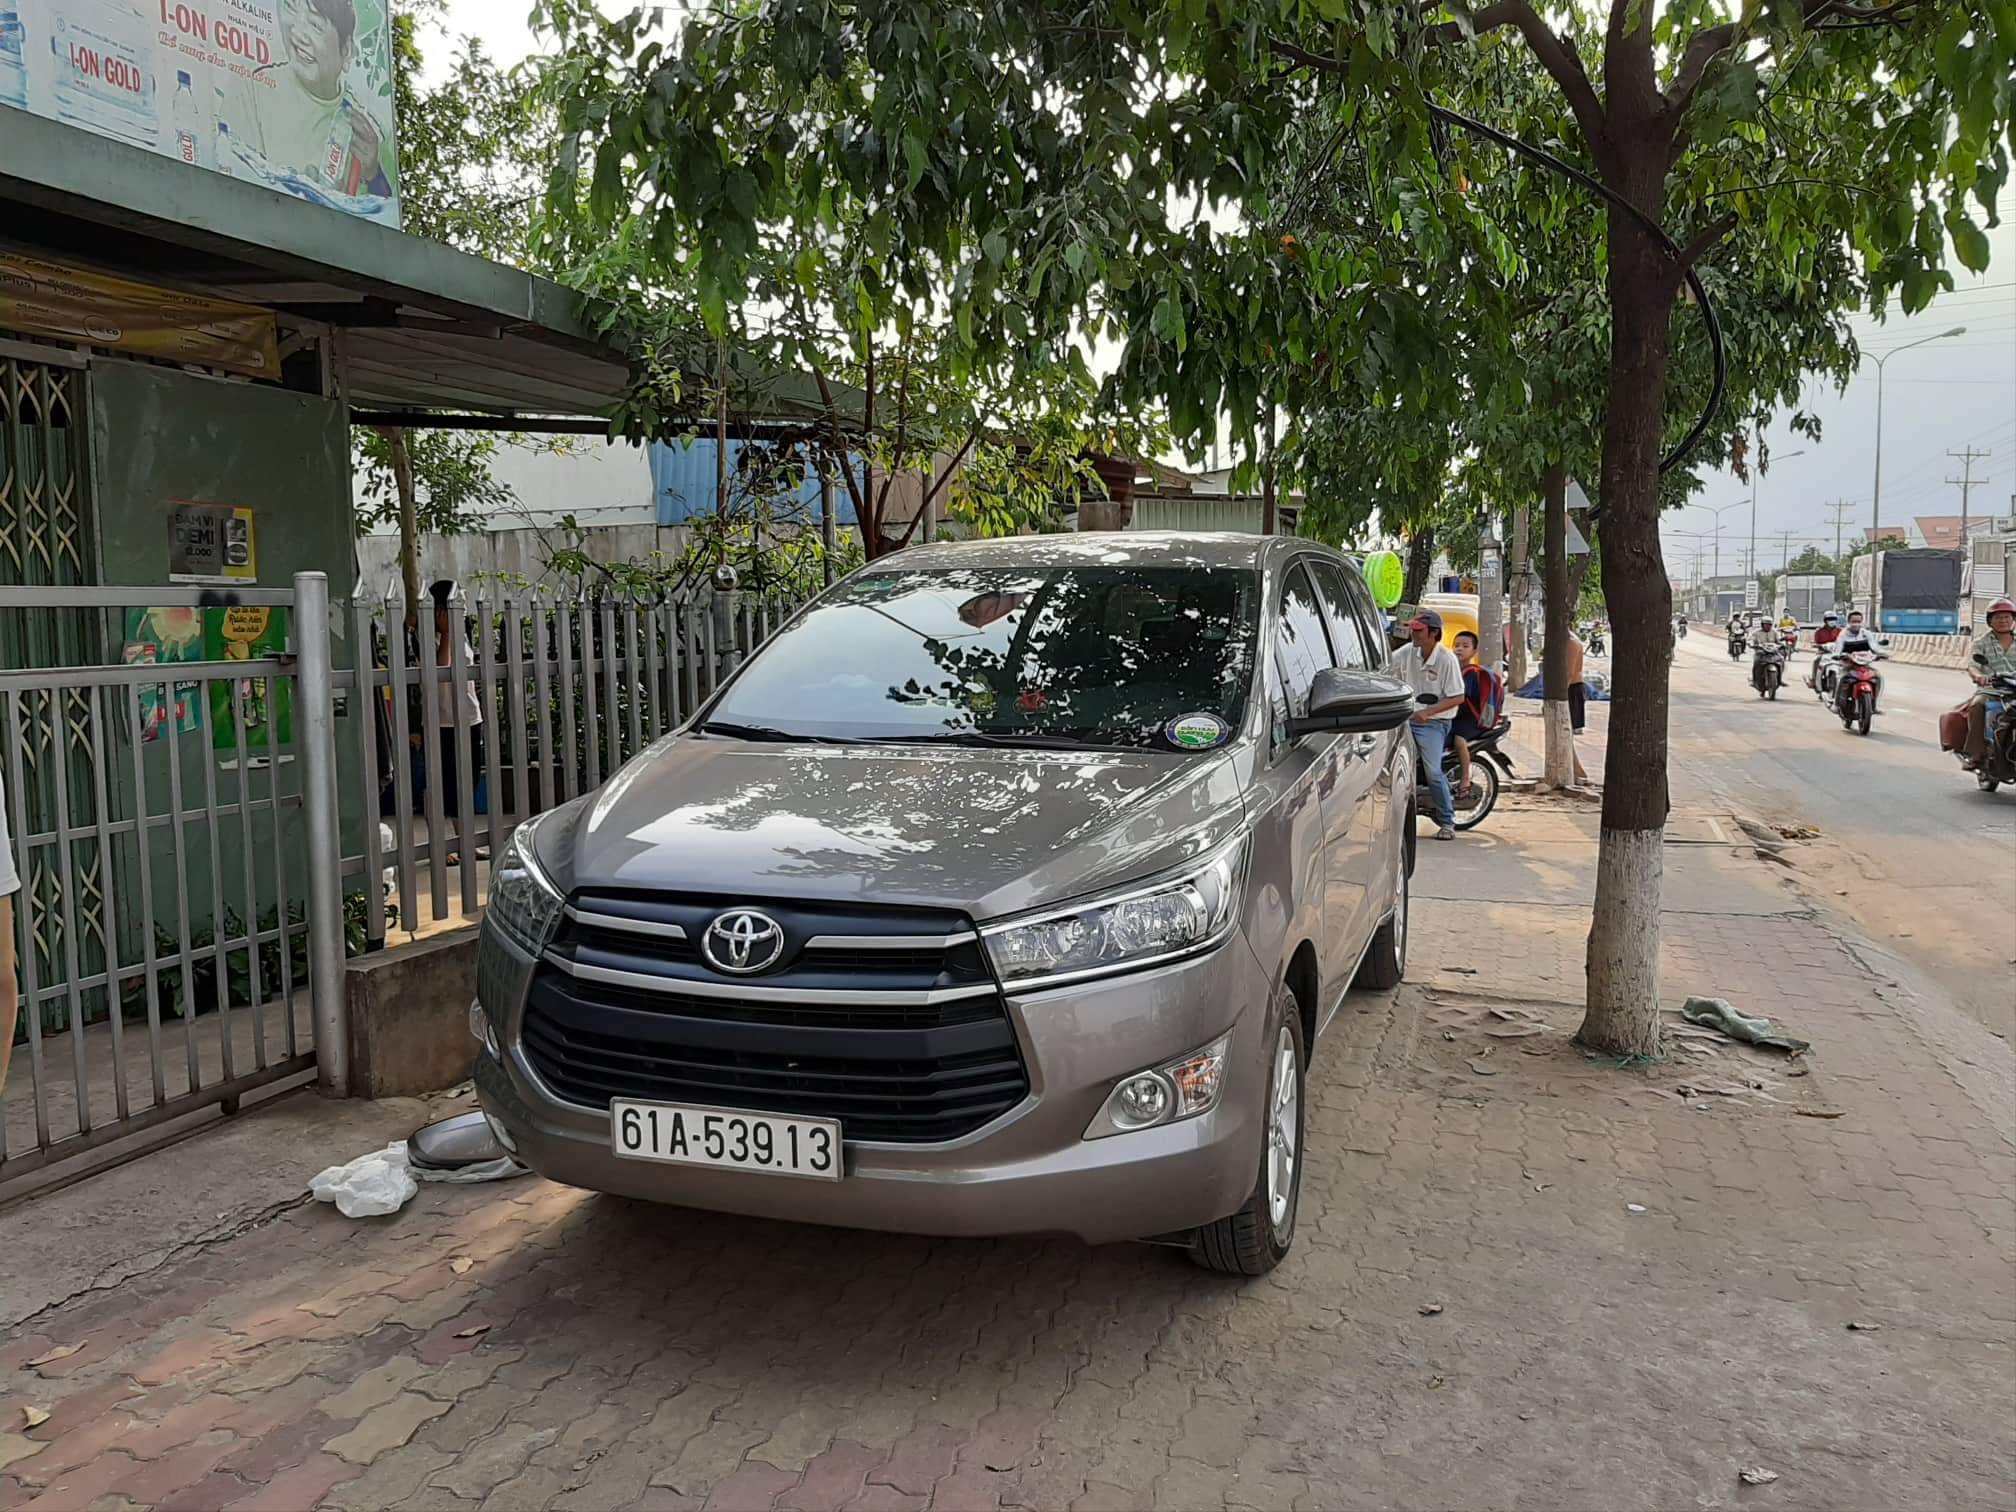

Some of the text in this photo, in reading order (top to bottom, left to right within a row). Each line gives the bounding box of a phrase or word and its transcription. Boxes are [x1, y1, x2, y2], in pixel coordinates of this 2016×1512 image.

[70, 41, 100, 79] I-ON
[105, 56, 140, 93] GOLD
[214, 20, 270, 65] GOLD
[622, 1108, 831, 1171] 61A-539.13
